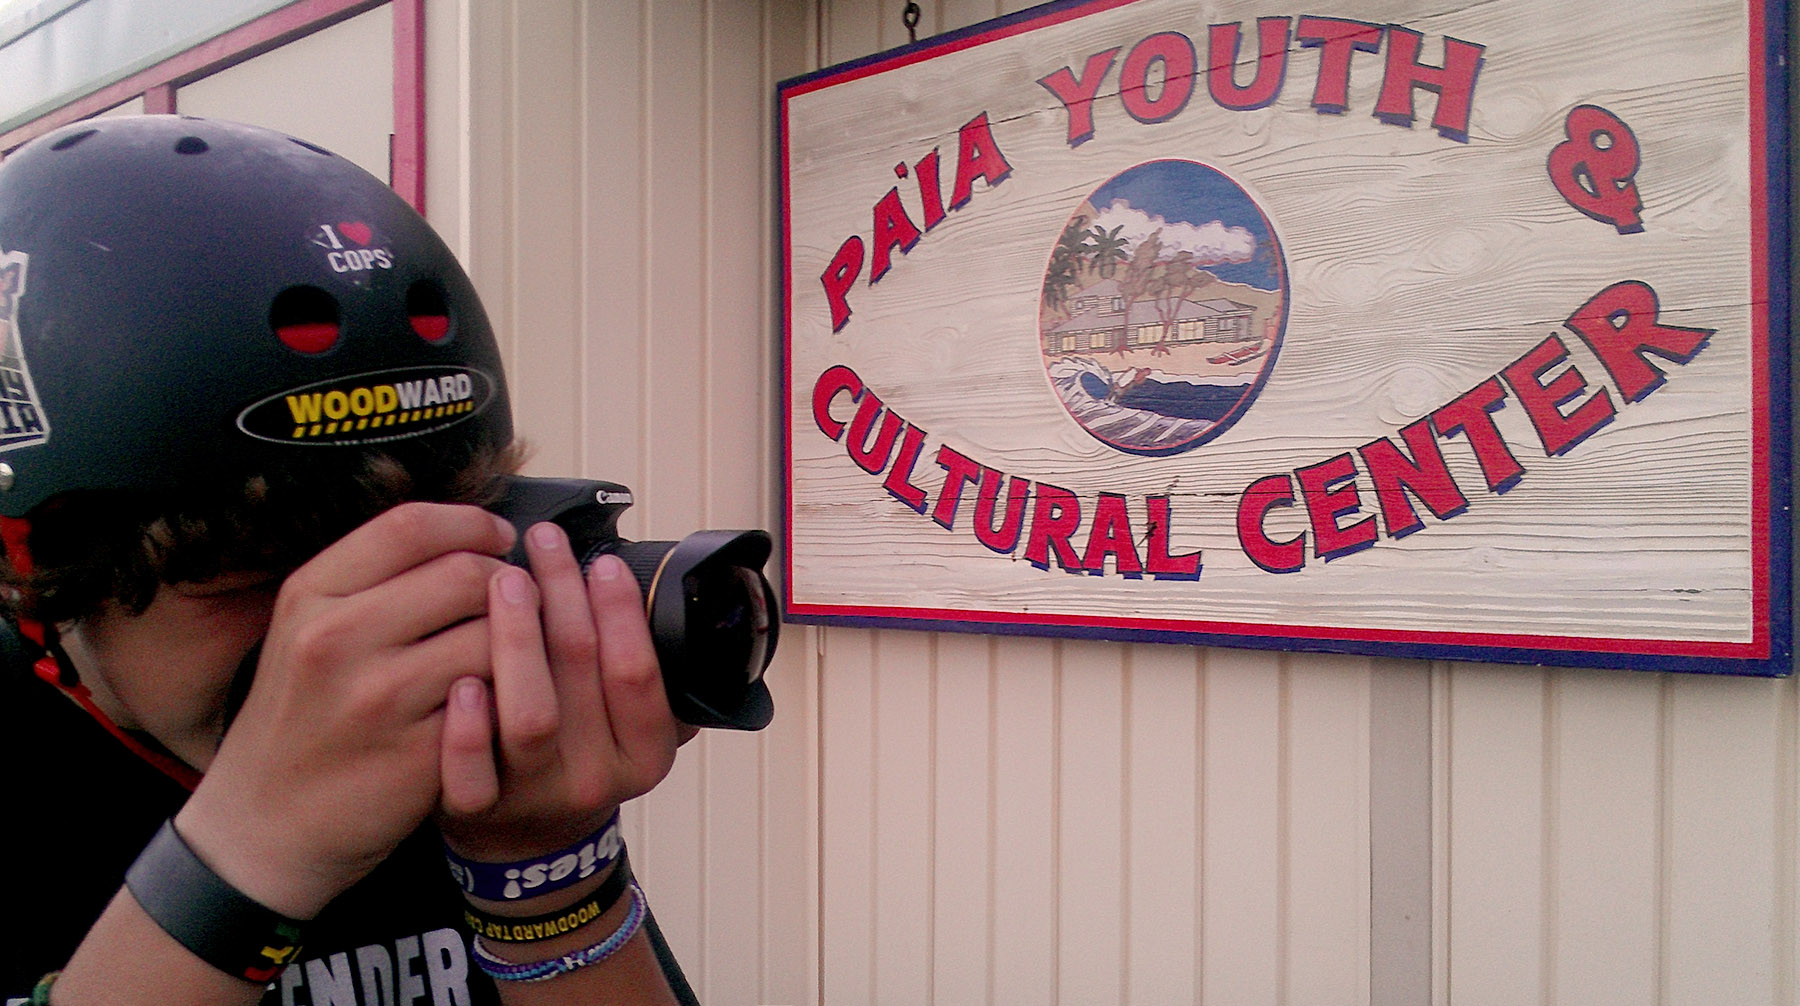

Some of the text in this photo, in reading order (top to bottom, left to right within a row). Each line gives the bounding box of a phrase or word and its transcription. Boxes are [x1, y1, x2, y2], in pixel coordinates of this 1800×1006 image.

[1036, 15, 1486, 148] YOUTH
[1546, 104, 1645, 235] &
[320, 224, 344, 249] I
[327, 249, 392, 273] COPS
[286, 373, 472, 424] WOODWARD
[812, 280, 1718, 582] CULTURAL CENTER
[513, 901, 601, 941] WOODWARD
